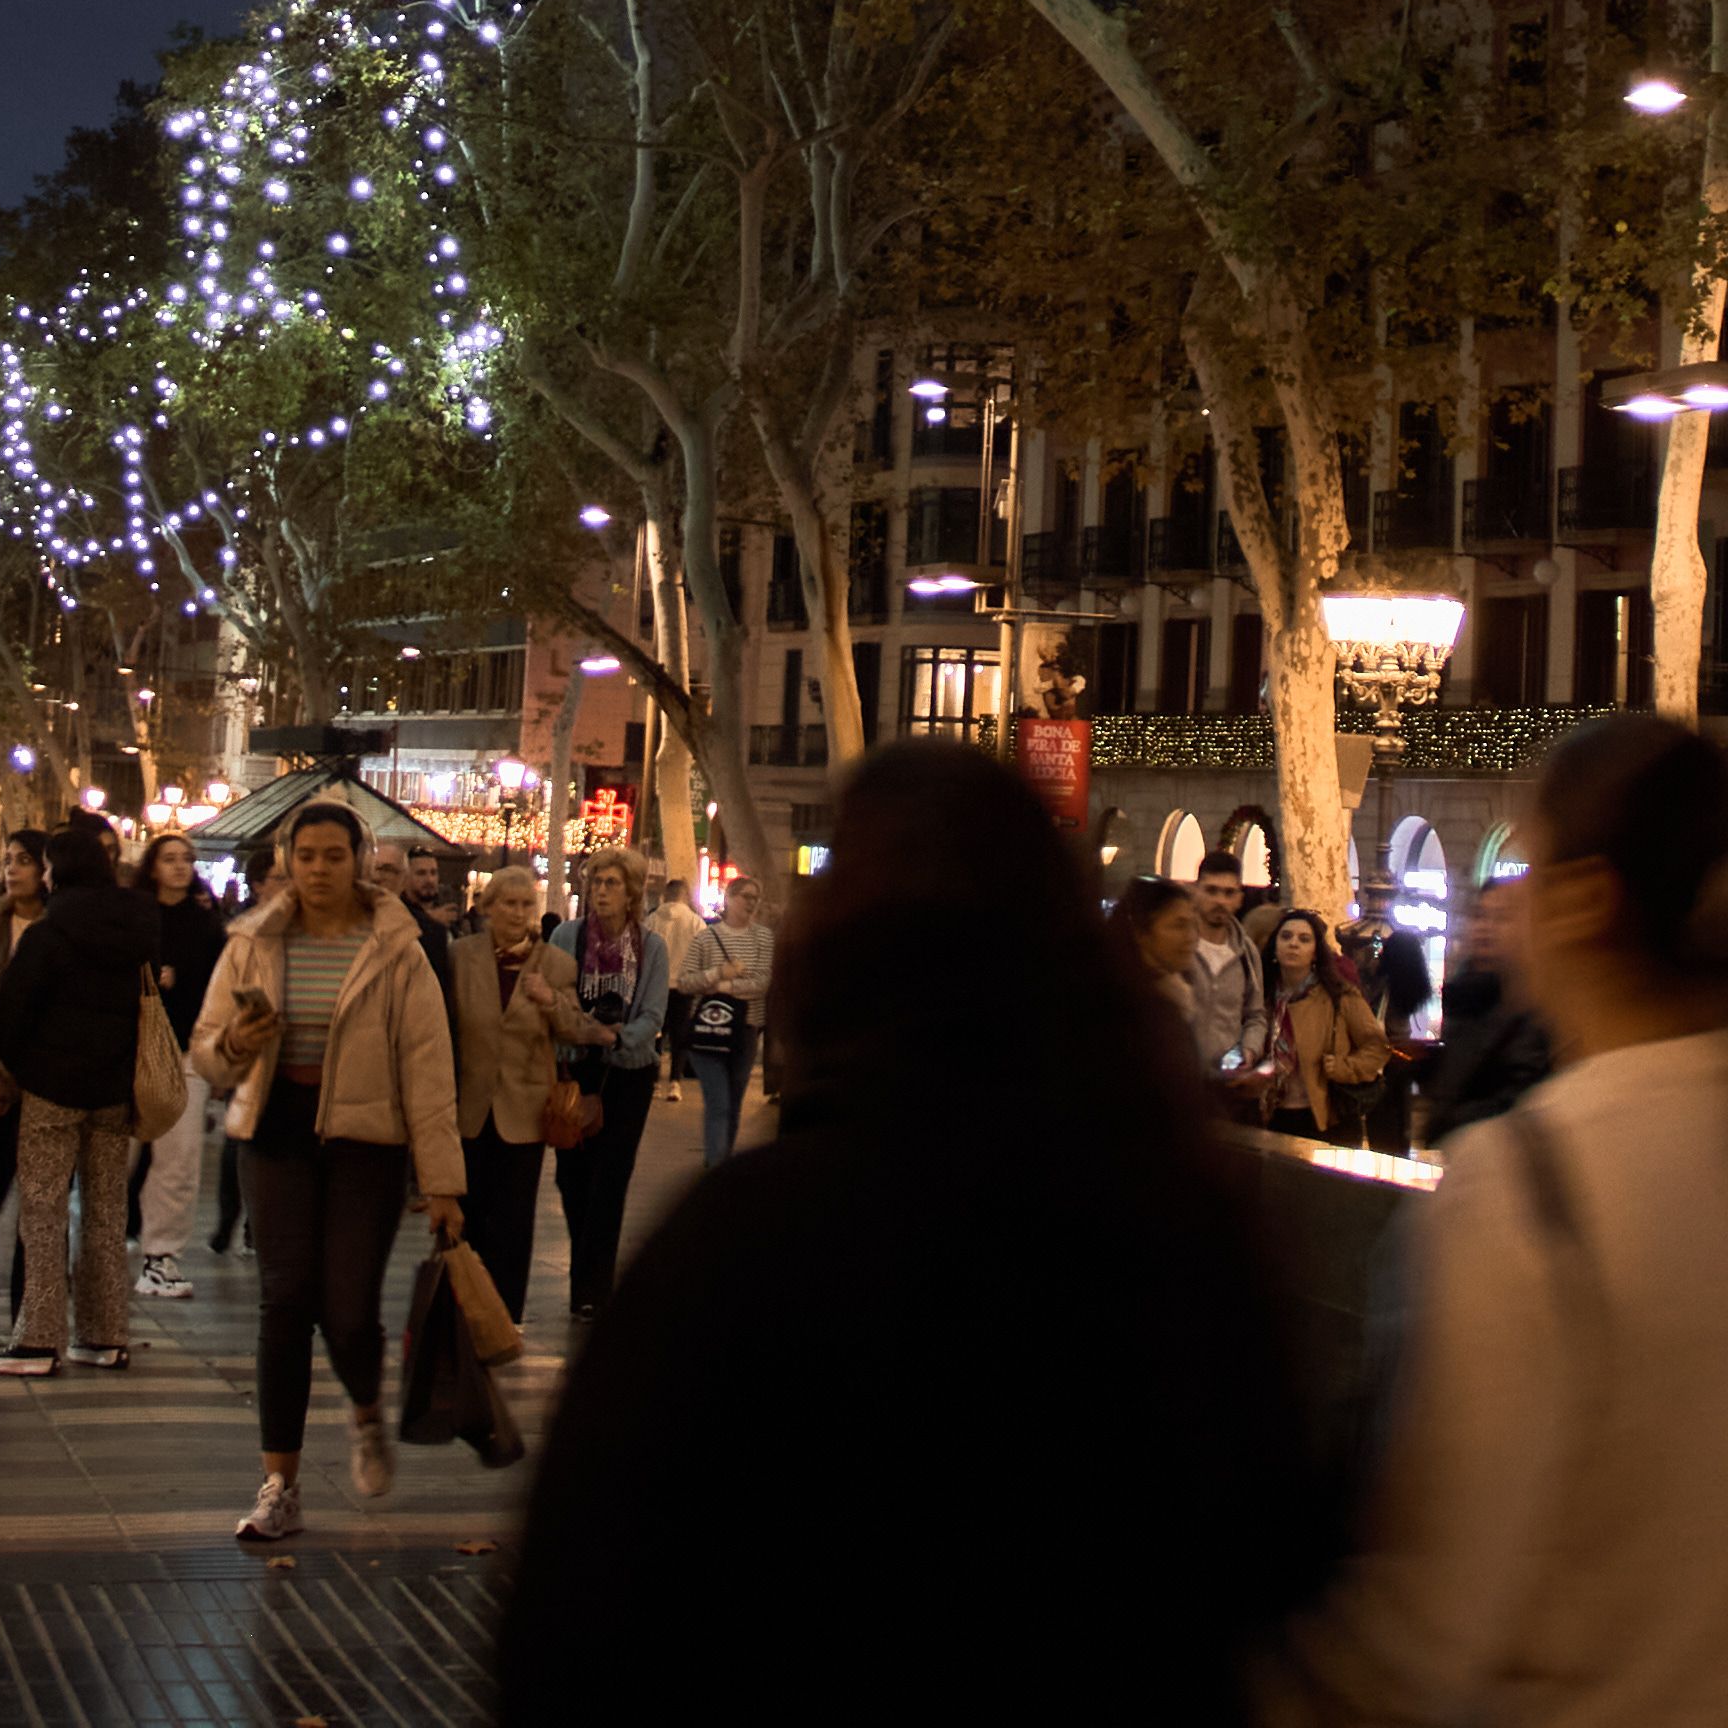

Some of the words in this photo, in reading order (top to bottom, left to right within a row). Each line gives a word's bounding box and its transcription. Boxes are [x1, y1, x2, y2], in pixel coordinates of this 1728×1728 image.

[1032, 724, 1074, 739] BONA
[1026, 738, 1058, 752] FIRA
[1061, 739, 1082, 753] DE
[1029, 751, 1076, 766] SANTA
